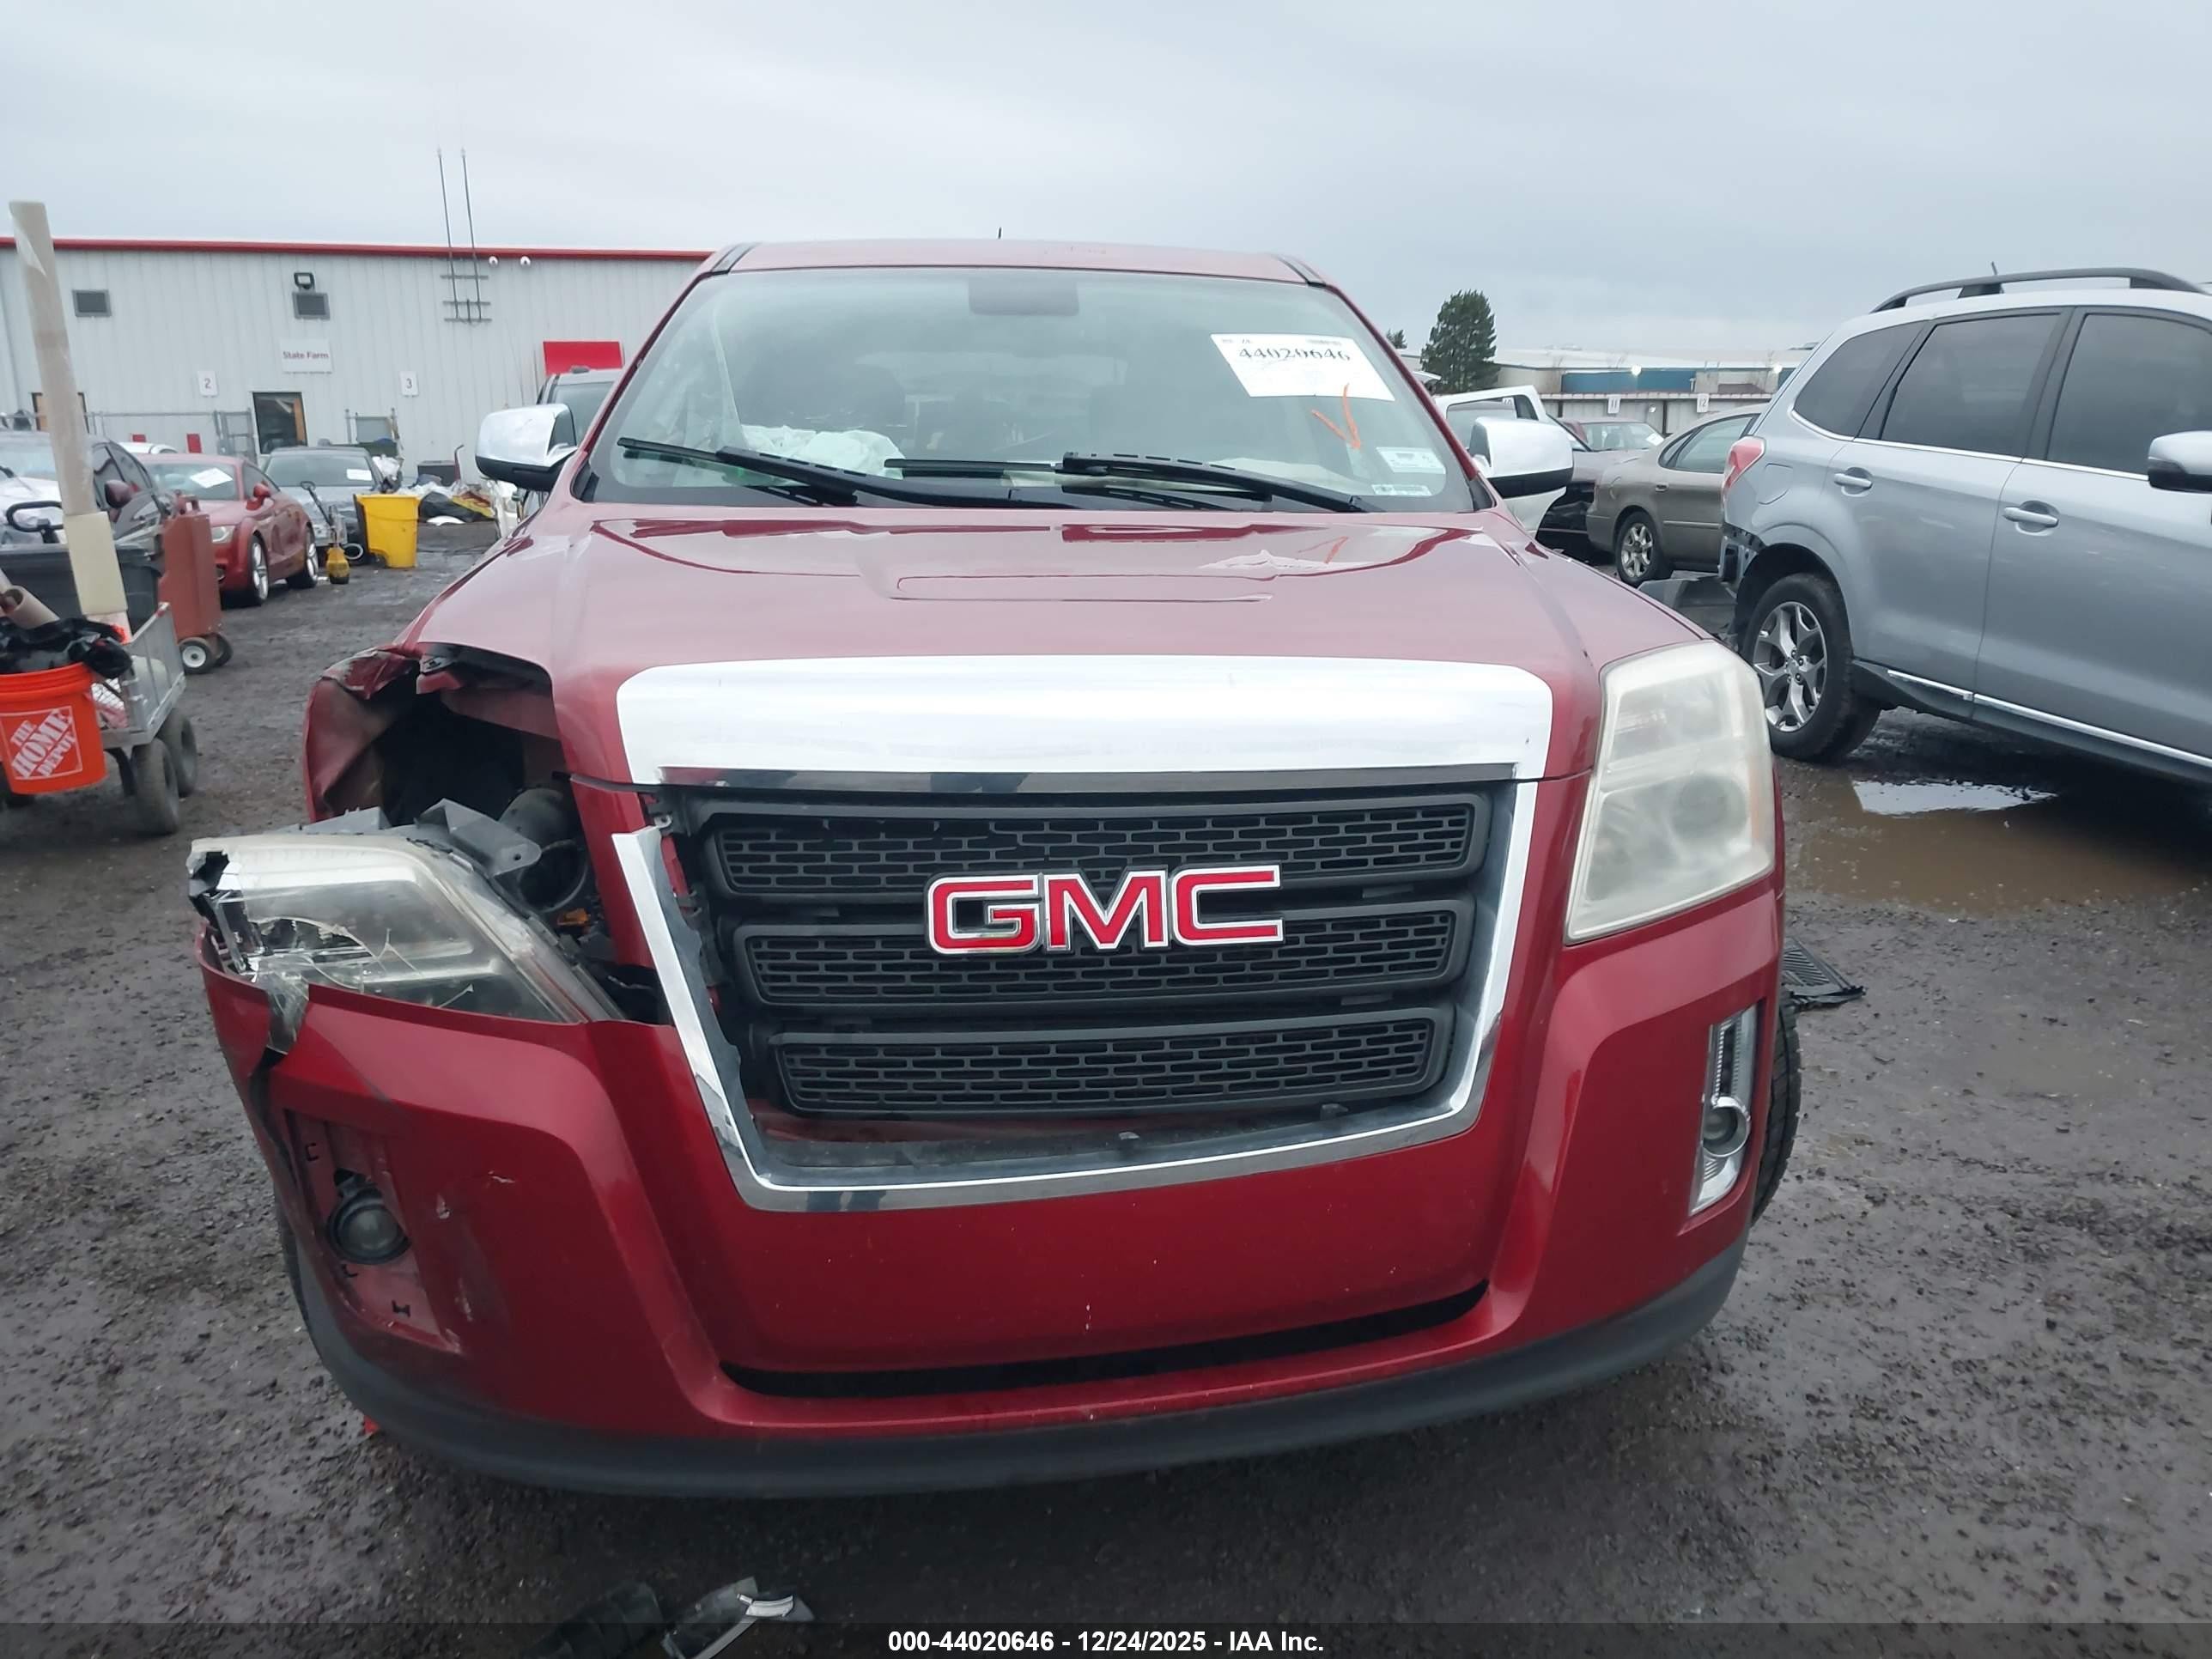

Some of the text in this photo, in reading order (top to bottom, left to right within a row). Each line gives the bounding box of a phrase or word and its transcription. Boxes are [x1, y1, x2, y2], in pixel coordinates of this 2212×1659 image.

[283, 350, 329, 359] State Farm
[204, 377, 212, 389] 2
[406, 377, 413, 389] 3
[9, 720, 38, 747] THE
[11, 708, 73, 778] HOME
[36, 730, 76, 778] DEPOT
[927, 865, 1285, 954] GMC
